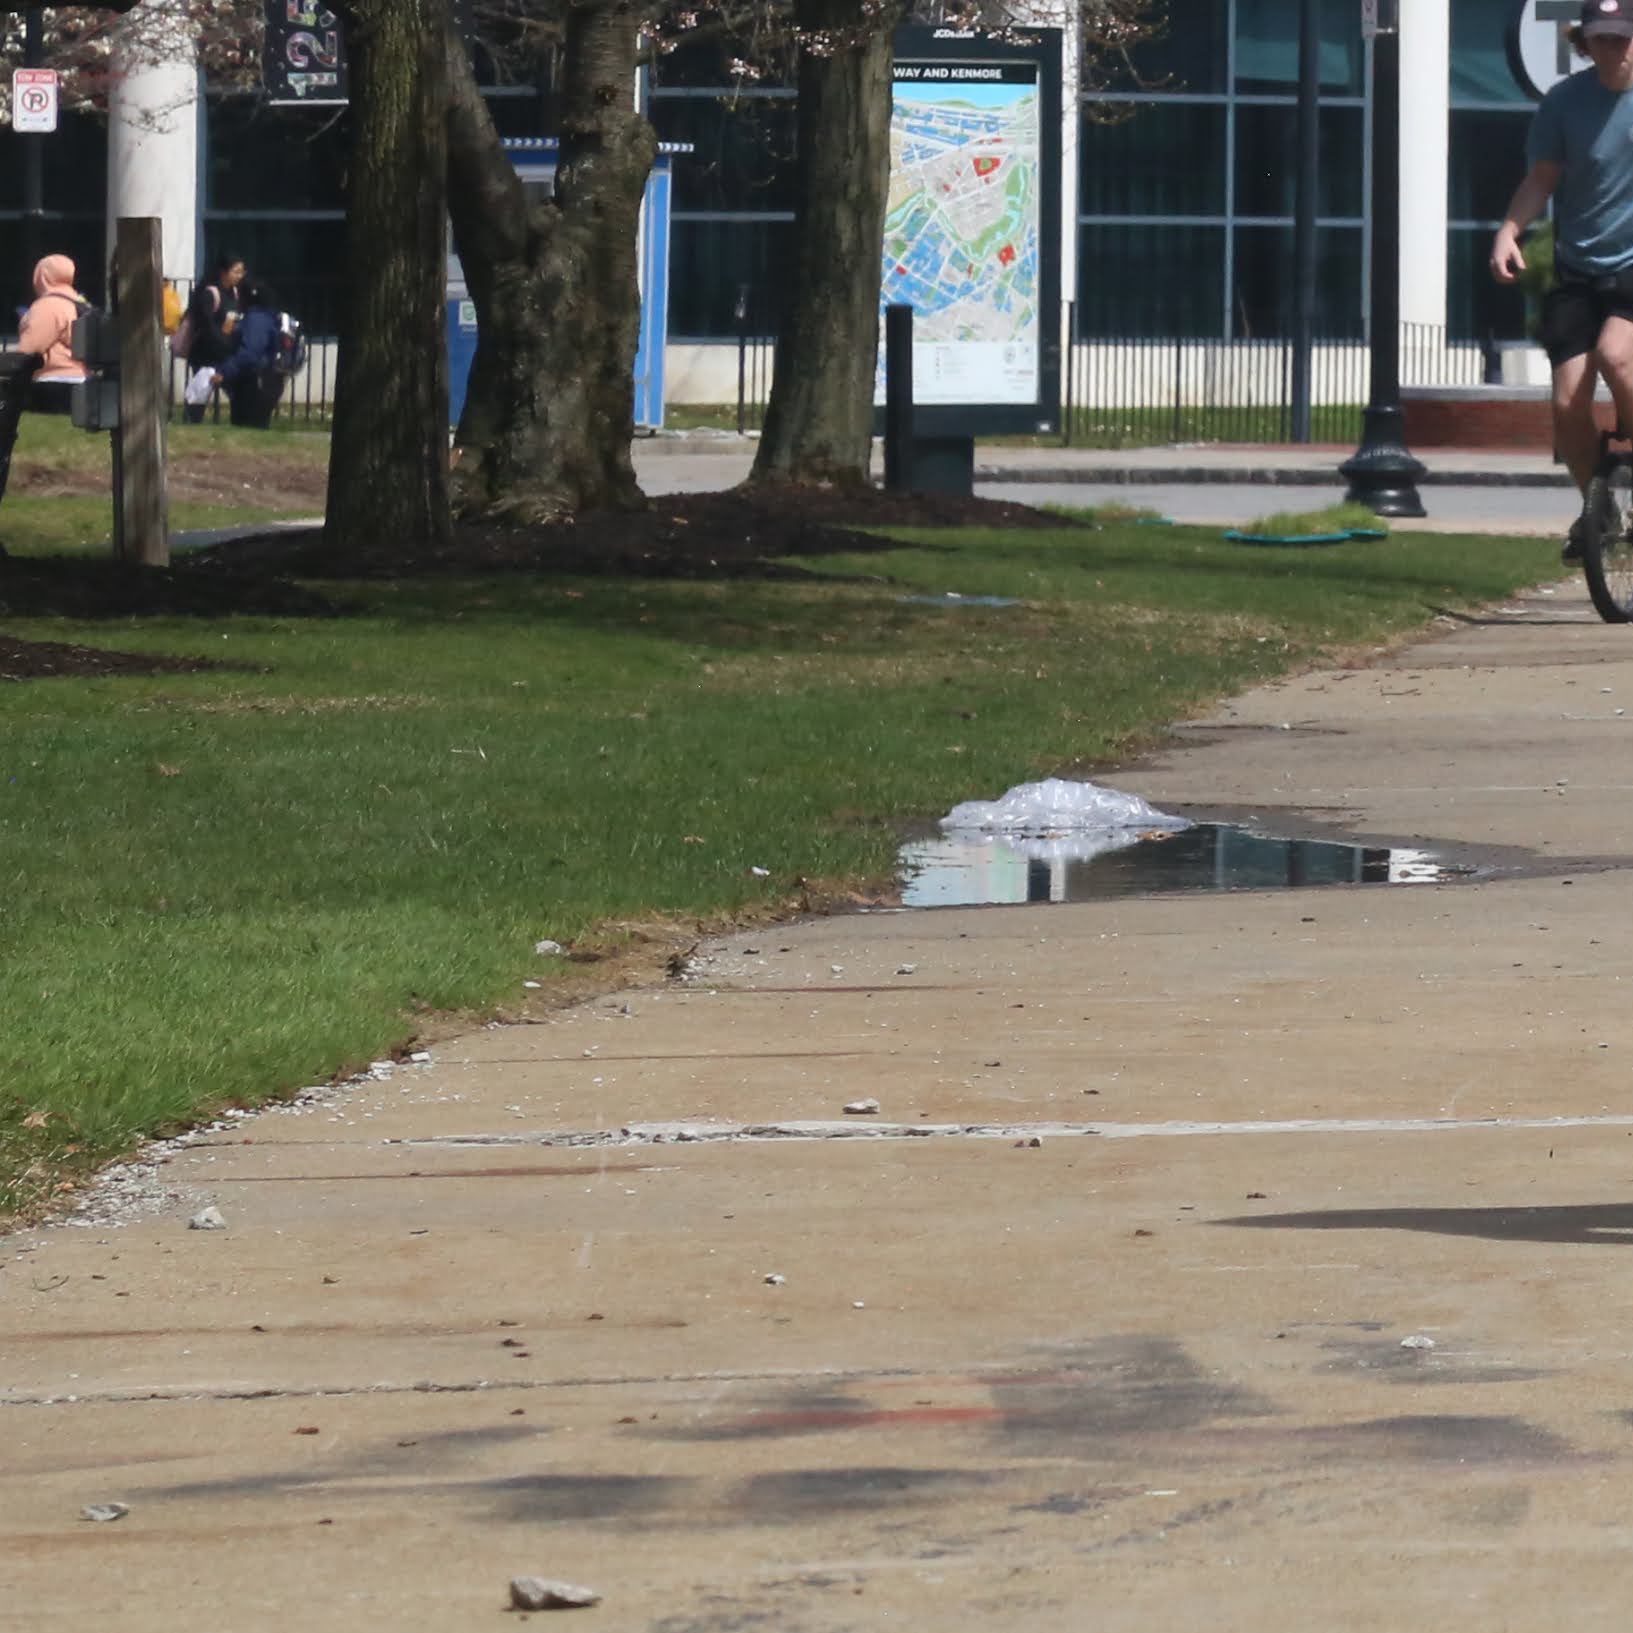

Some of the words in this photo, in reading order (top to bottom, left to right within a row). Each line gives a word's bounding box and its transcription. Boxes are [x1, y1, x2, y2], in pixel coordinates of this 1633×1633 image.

[1535, 0, 1583, 74] T
[923, 68, 949, 79] AND
[951, 68, 1002, 79] KENMORE
